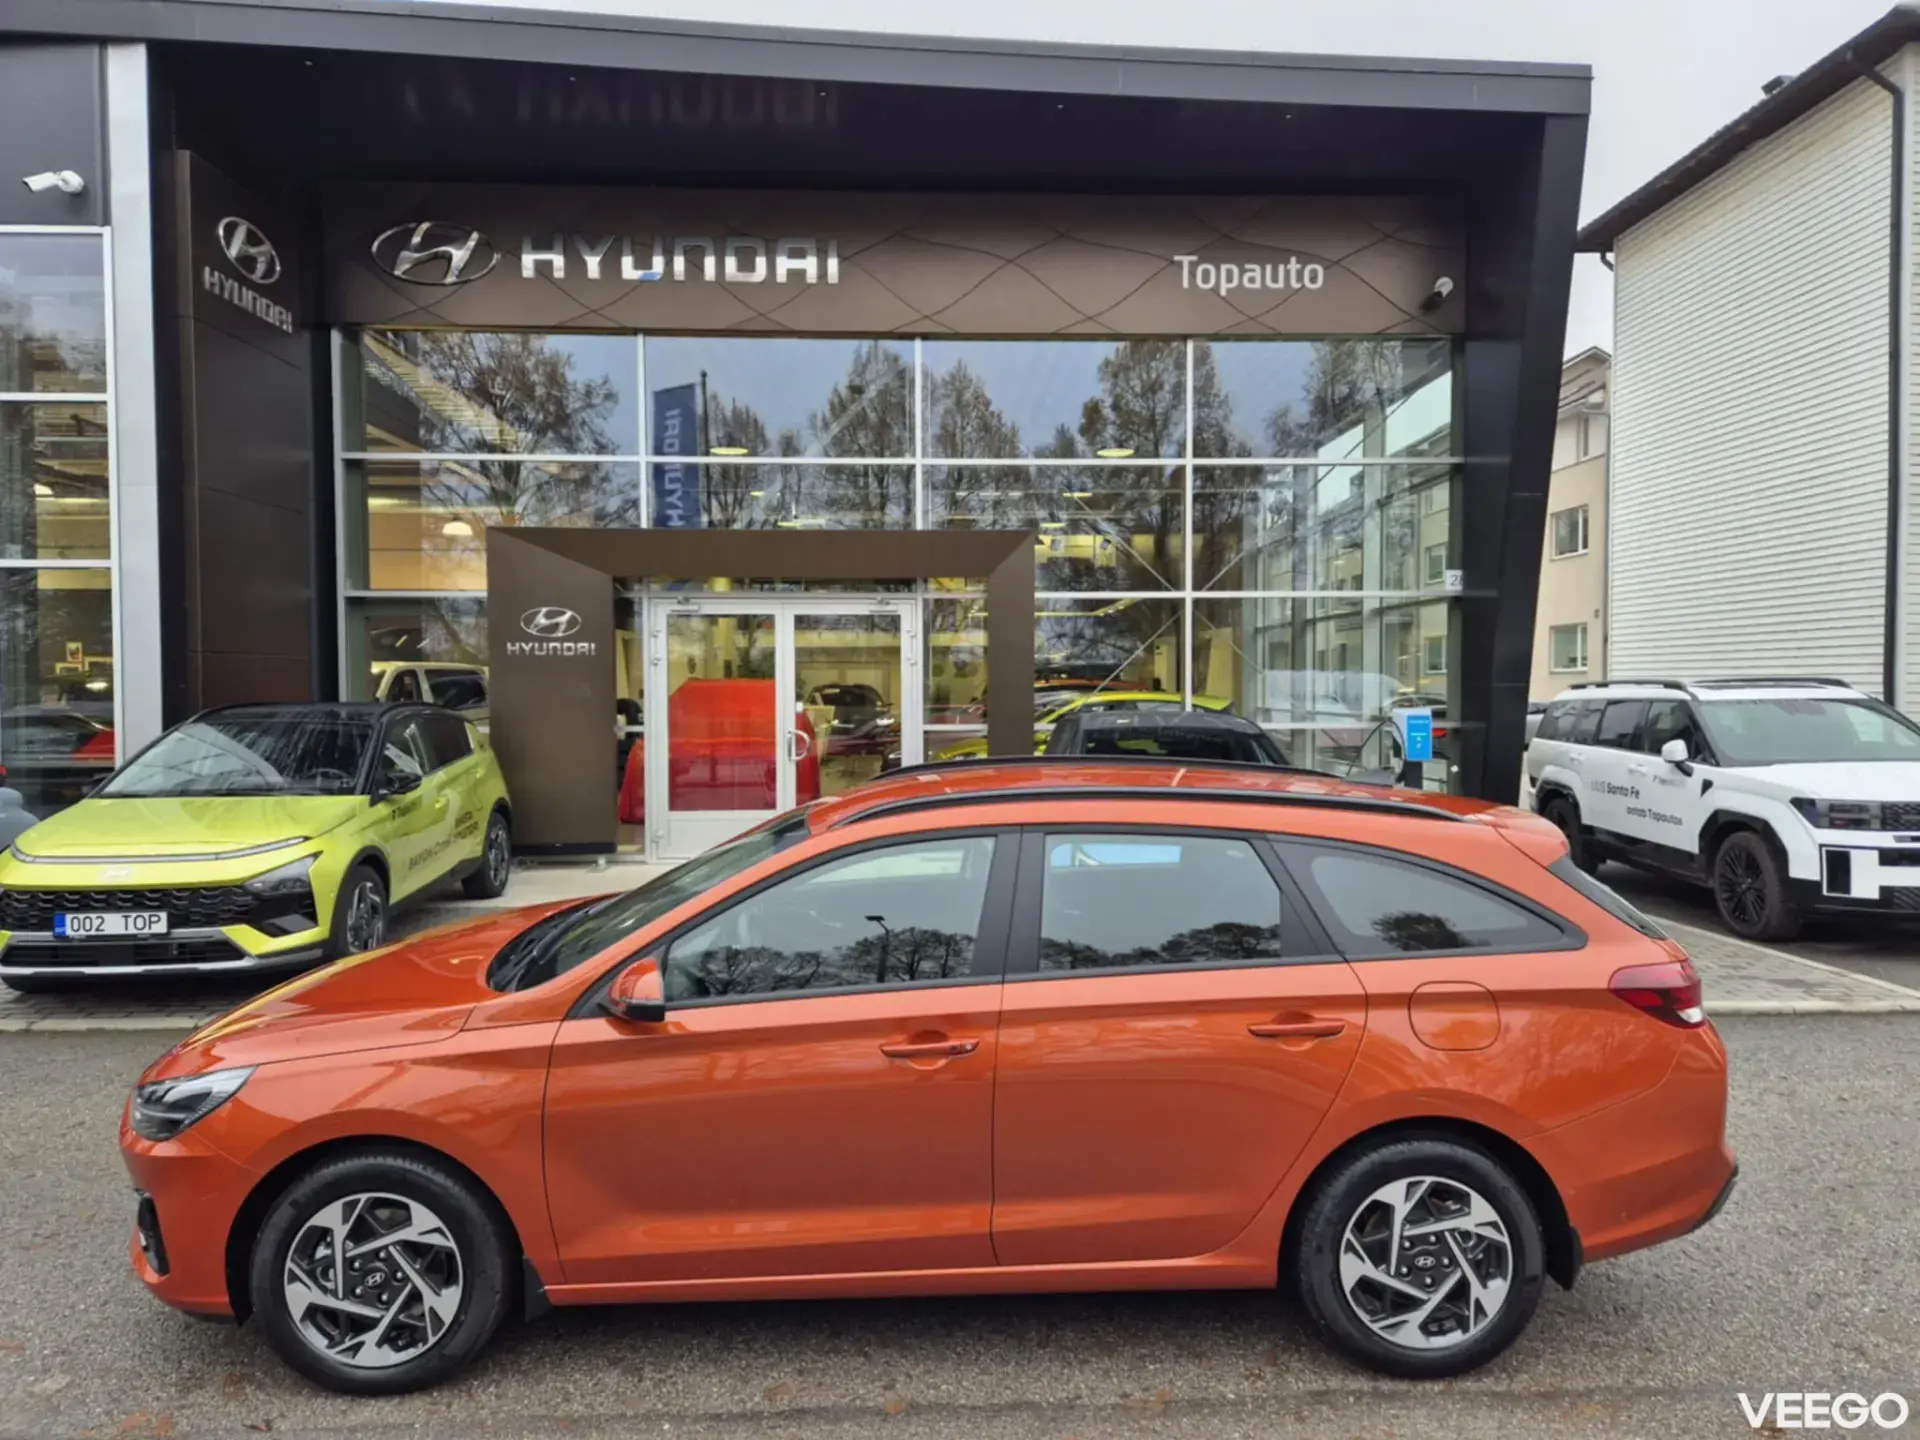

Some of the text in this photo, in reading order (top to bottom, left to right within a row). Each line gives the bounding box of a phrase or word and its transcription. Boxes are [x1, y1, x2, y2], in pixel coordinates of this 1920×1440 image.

[521, 234, 839, 284] HYUNDAI
[1173, 254, 1325, 297] Topauto
[203, 265, 292, 334] HYUNDAI
[506, 641, 597, 656] HYUNDAI
[1606, 782, 1629, 797] Santa
[1630, 786, 1640, 799] Fe
[70, 913, 161, 932] 002 TOP
